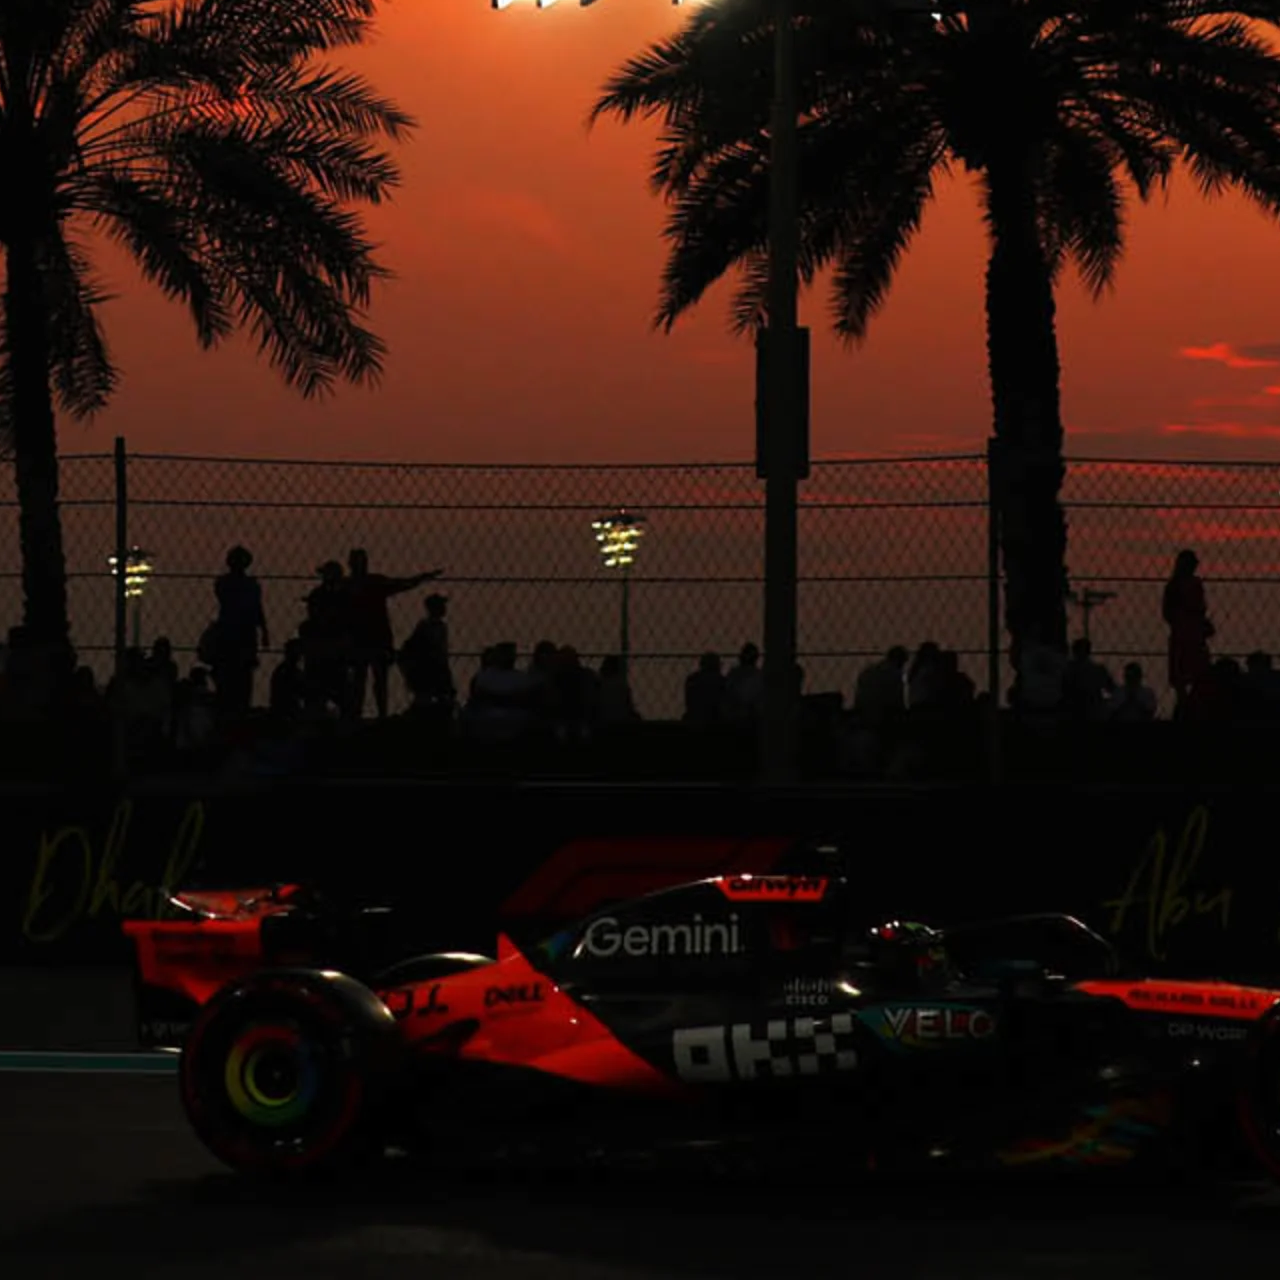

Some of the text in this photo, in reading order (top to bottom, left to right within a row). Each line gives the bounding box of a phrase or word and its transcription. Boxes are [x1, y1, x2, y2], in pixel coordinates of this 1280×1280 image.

[21, 797, 206, 944] Dhab
[1101, 803, 1233, 962] Abu
[585, 912, 740, 957] Gemini
[673, 1012, 858, 1083] OKX
[883, 1007, 996, 1040] VELO
